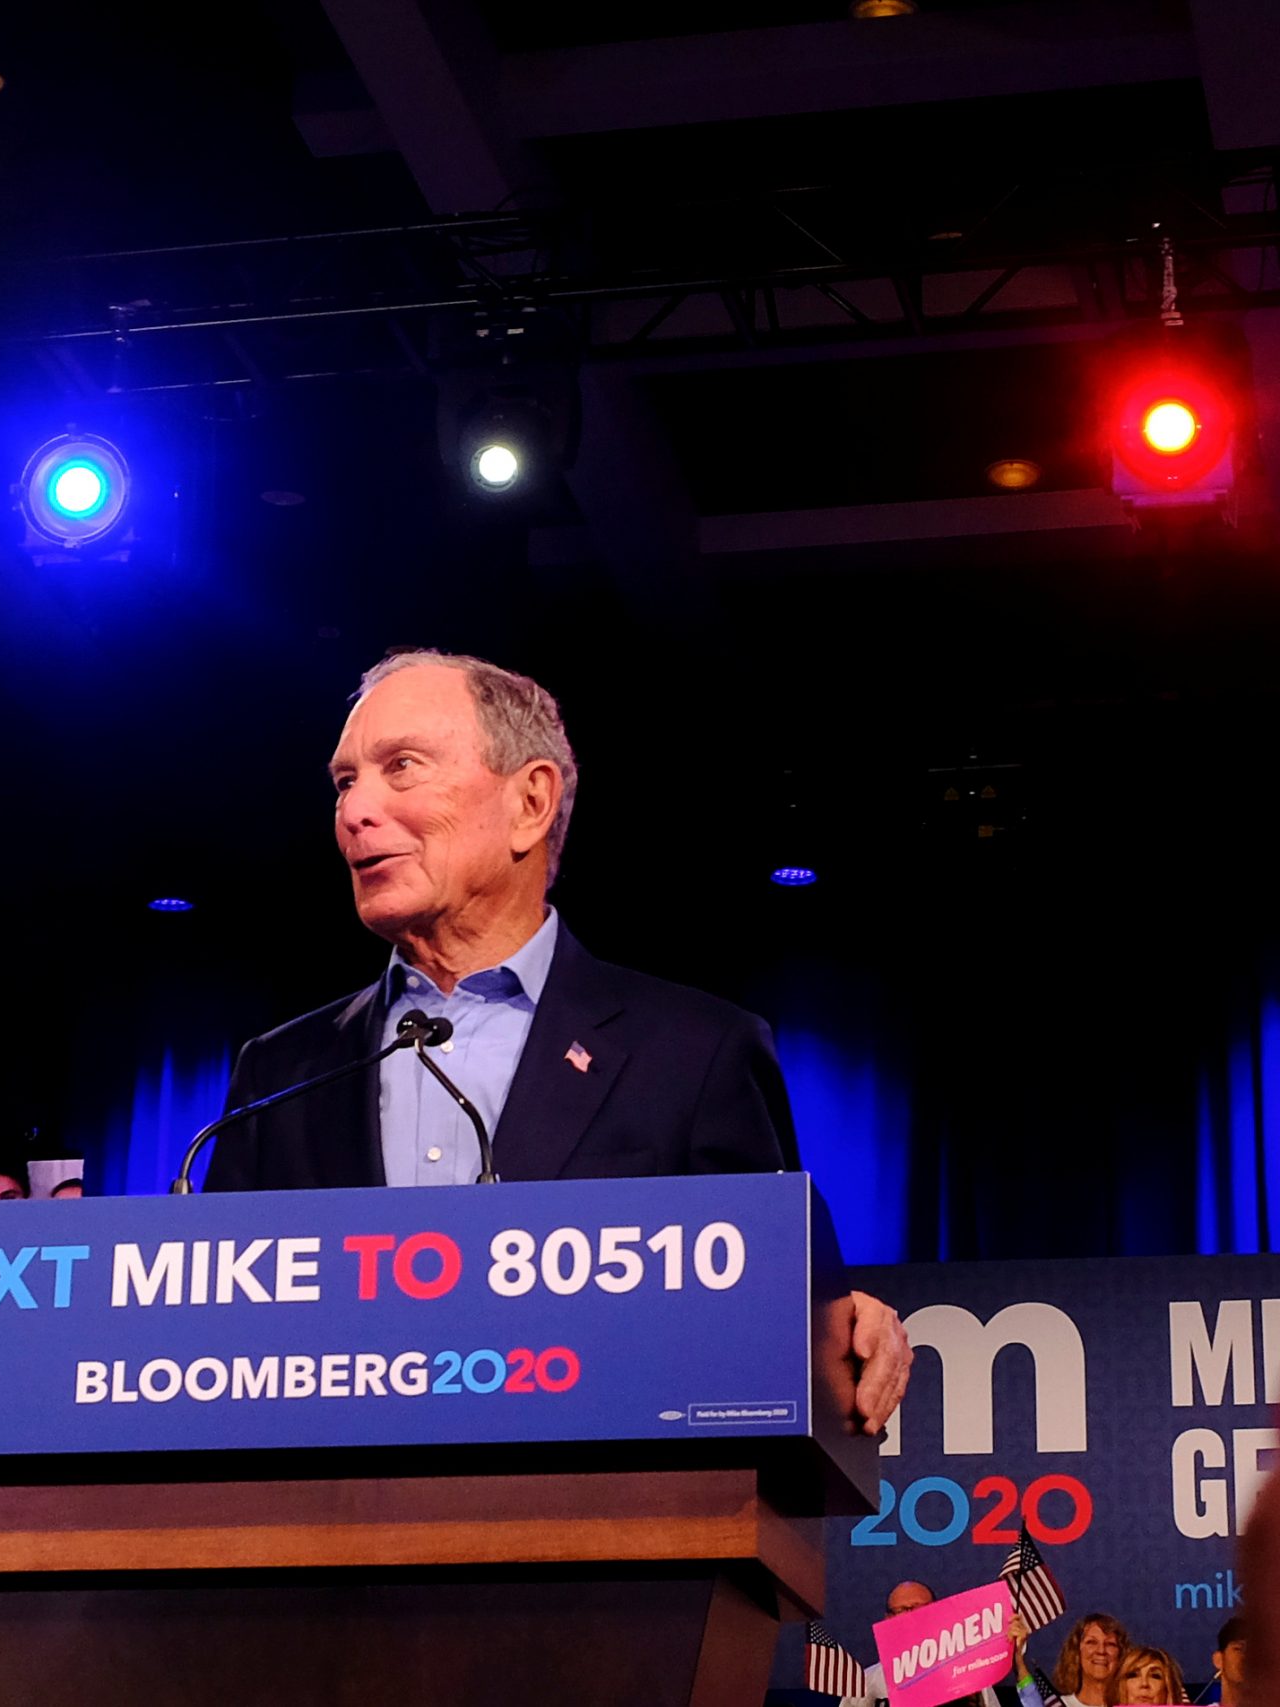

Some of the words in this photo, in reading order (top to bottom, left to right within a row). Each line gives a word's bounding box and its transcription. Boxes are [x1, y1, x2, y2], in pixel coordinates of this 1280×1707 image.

[111, 1237, 321, 1307] MIKE
[343, 1232, 462, 1300] TO
[488, 1221, 746, 1297] 80510
[76, 1346, 580, 1404] BLOOMBERG2020
[850, 1474, 1093, 1547] 2020
[893, 1603, 1002, 1684] WOMEN
